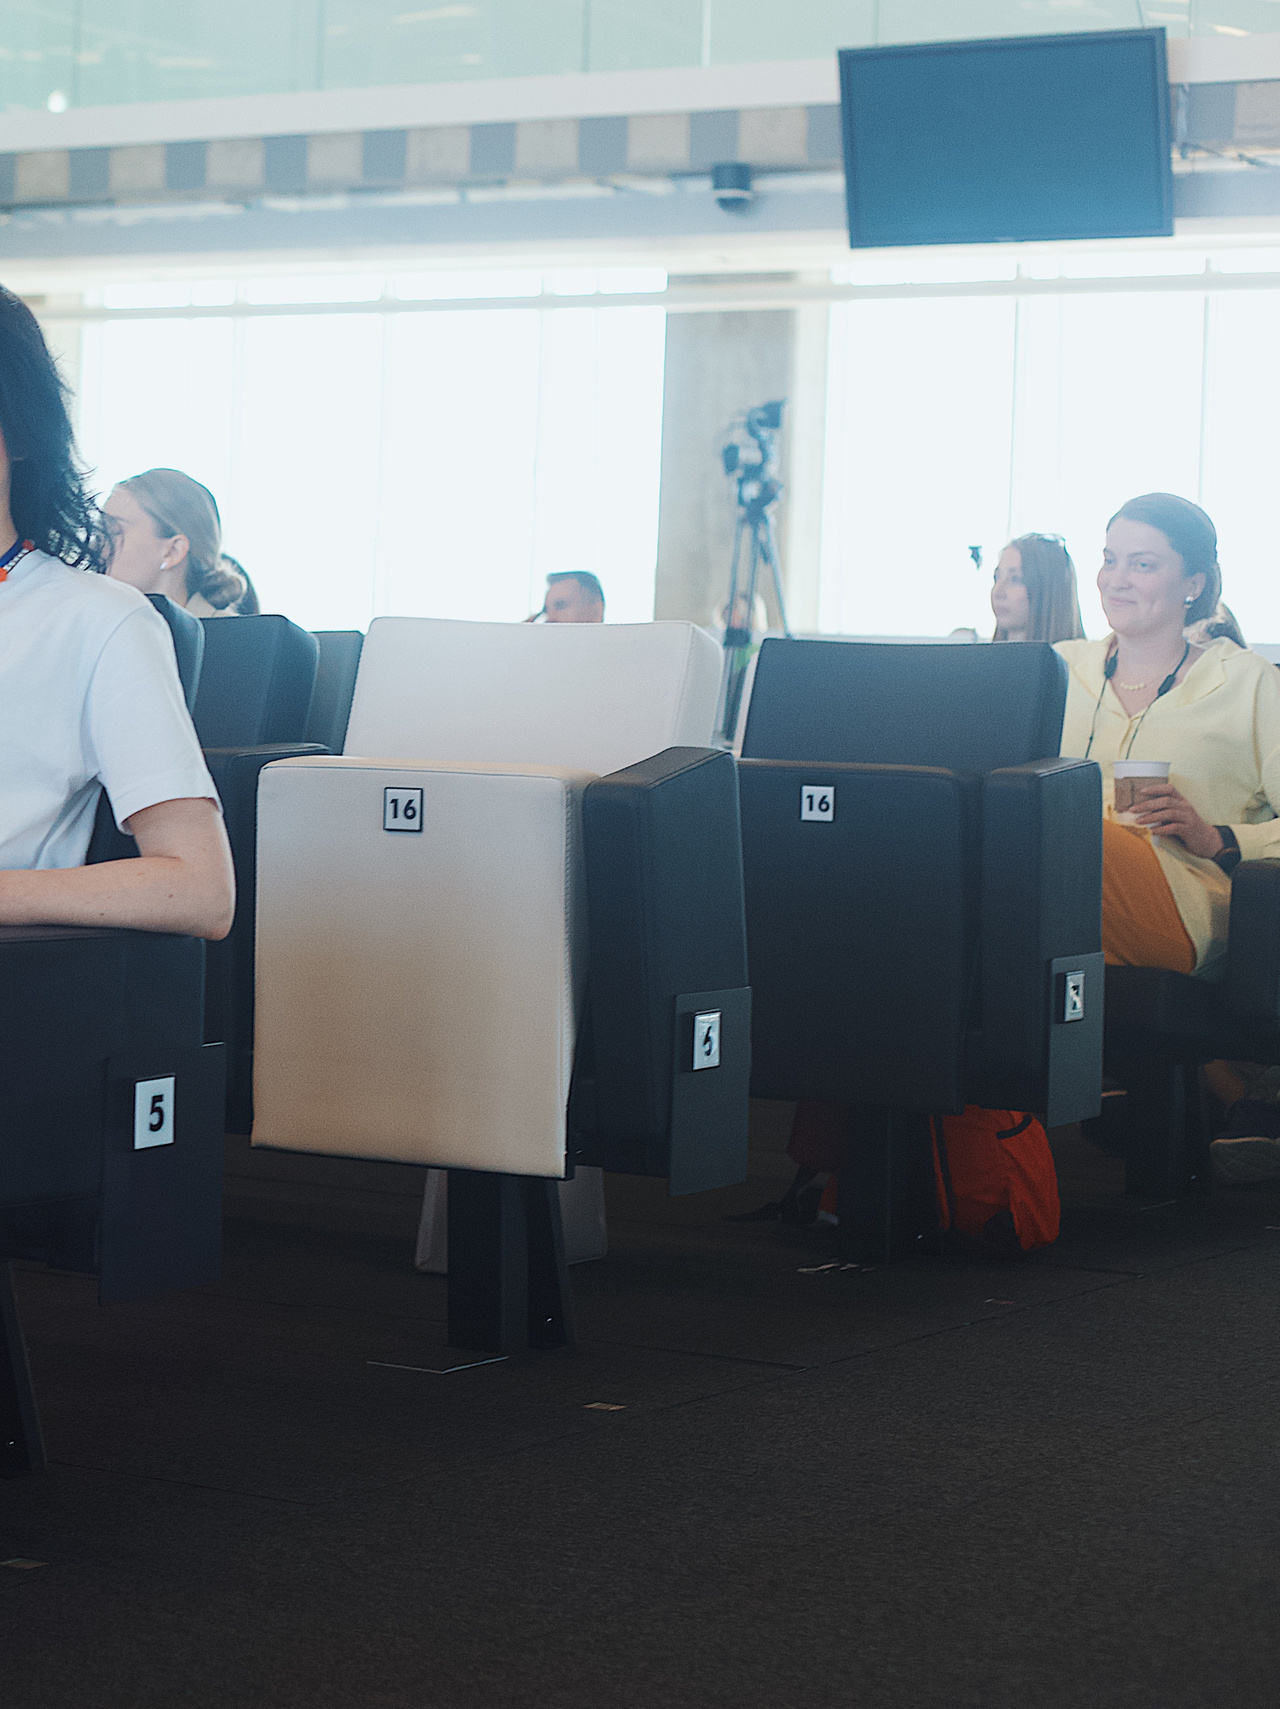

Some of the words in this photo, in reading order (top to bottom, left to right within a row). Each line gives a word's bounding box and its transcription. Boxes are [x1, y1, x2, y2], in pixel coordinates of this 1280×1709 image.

[389, 798, 417, 820] 16
[806, 794, 830, 813] 16
[149, 1093, 165, 1132] 5
